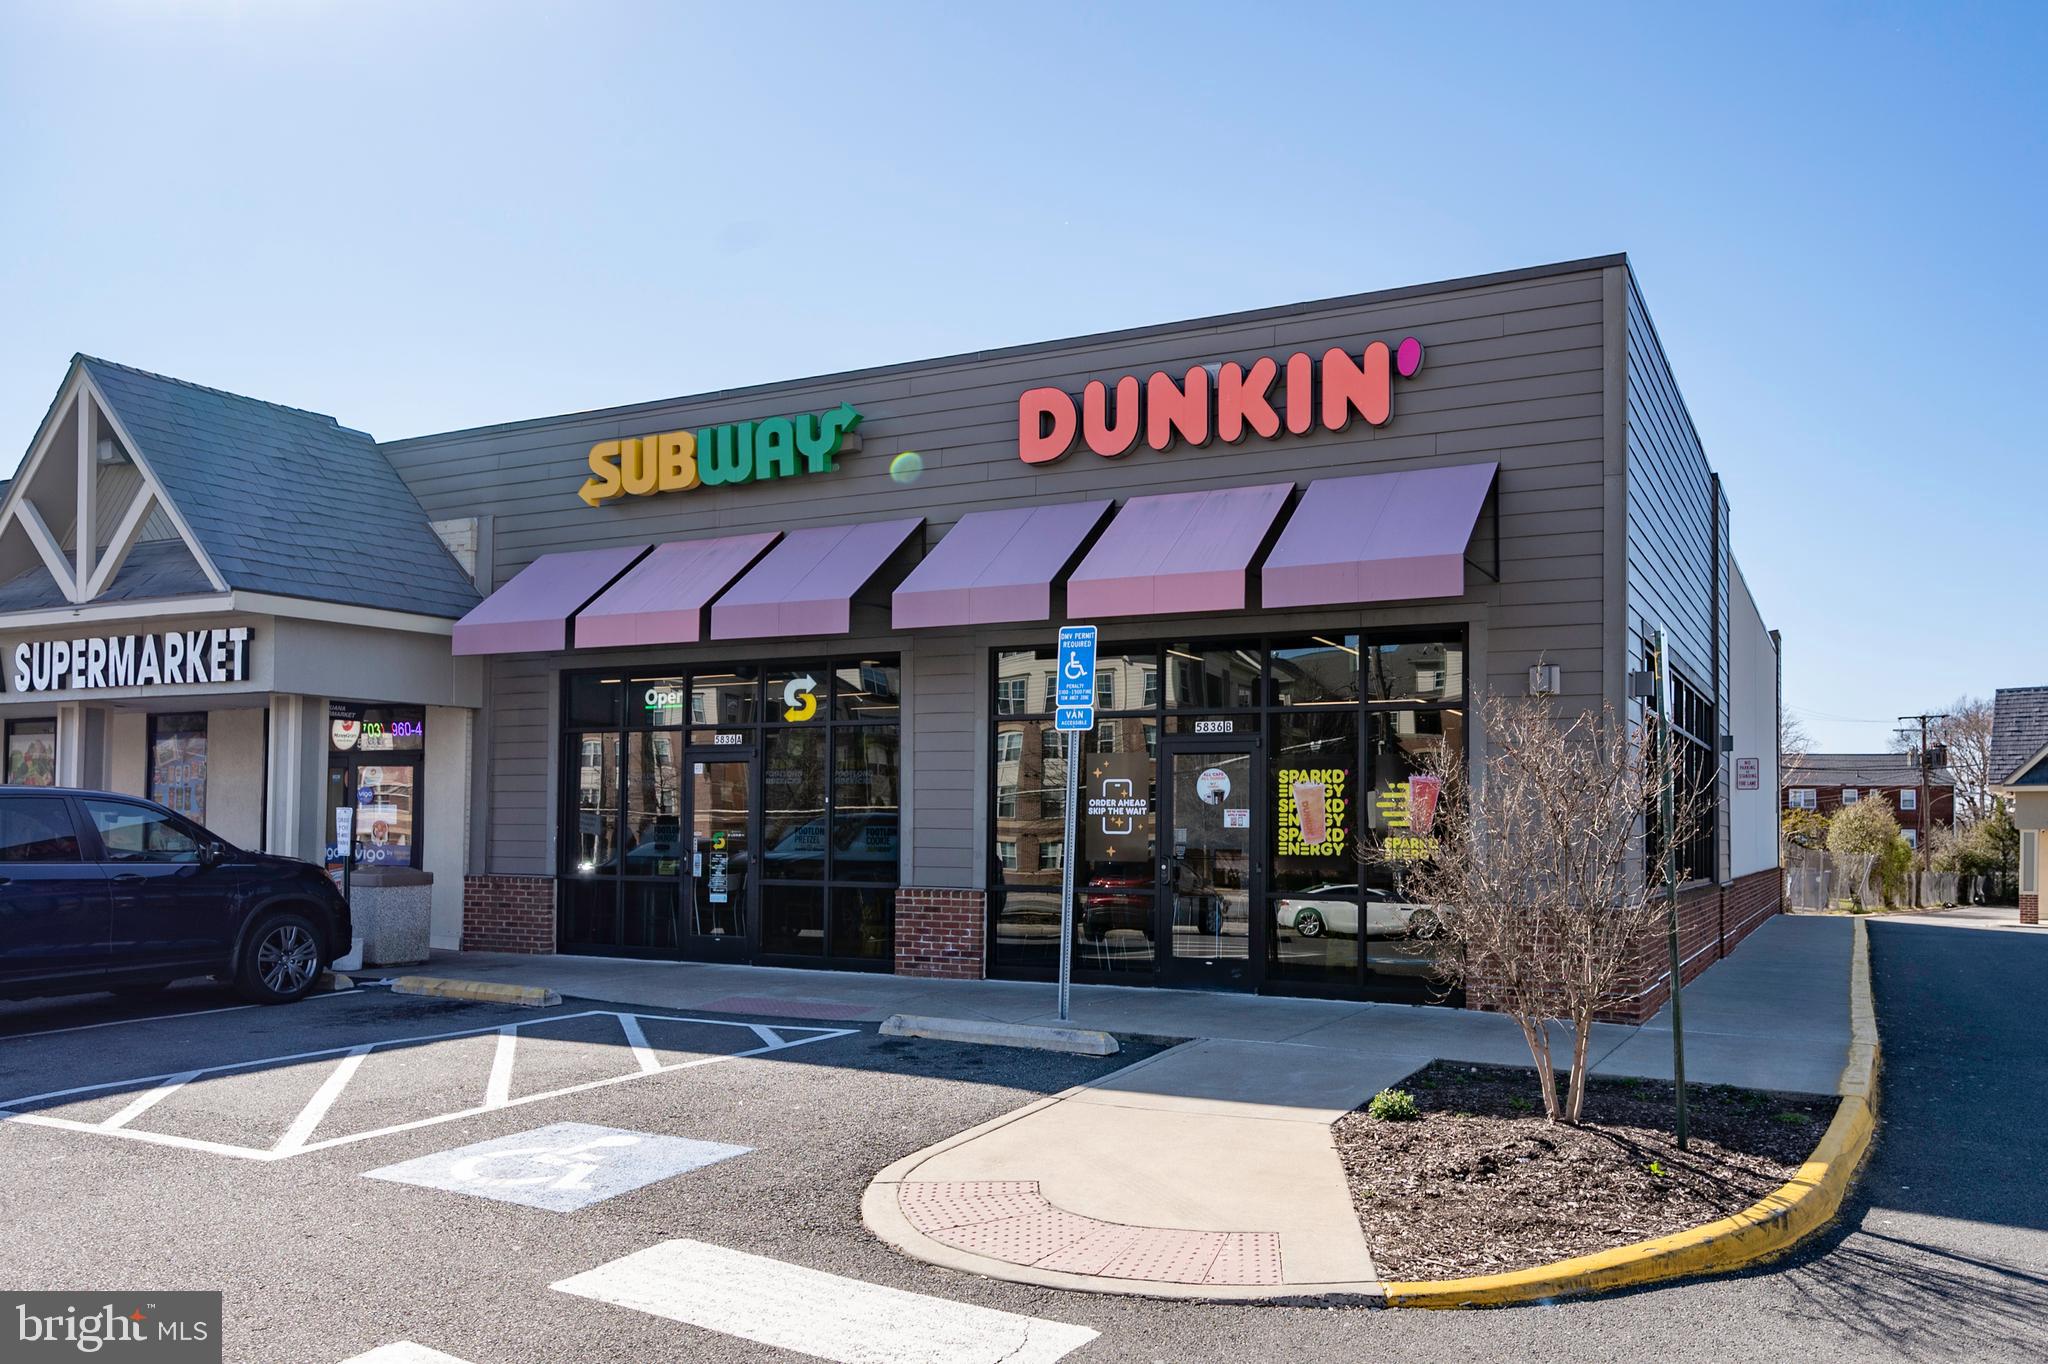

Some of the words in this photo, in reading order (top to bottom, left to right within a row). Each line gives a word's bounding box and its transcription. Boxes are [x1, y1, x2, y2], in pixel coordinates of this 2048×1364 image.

[1019, 336, 1422, 464] DUNKIN'
[577, 400, 863, 507] SUBWAY
[15, 627, 248, 692] SUPERMARKET
[1066, 711, 1084, 719] VAN
[391, 721, 422, 737] 960-4
[1089, 799, 1116, 807] ORDER
[1118, 799, 1146, 807] AHEAD
[1088, 807, 1106, 815] SKIP
[1108, 807, 1123, 815] THE
[1125, 807, 1147, 815] WAIT
[795, 827, 824, 835] FOOTLON
[355, 849, 386, 862] vigo
[1278, 843, 1345, 856] ENERGY
